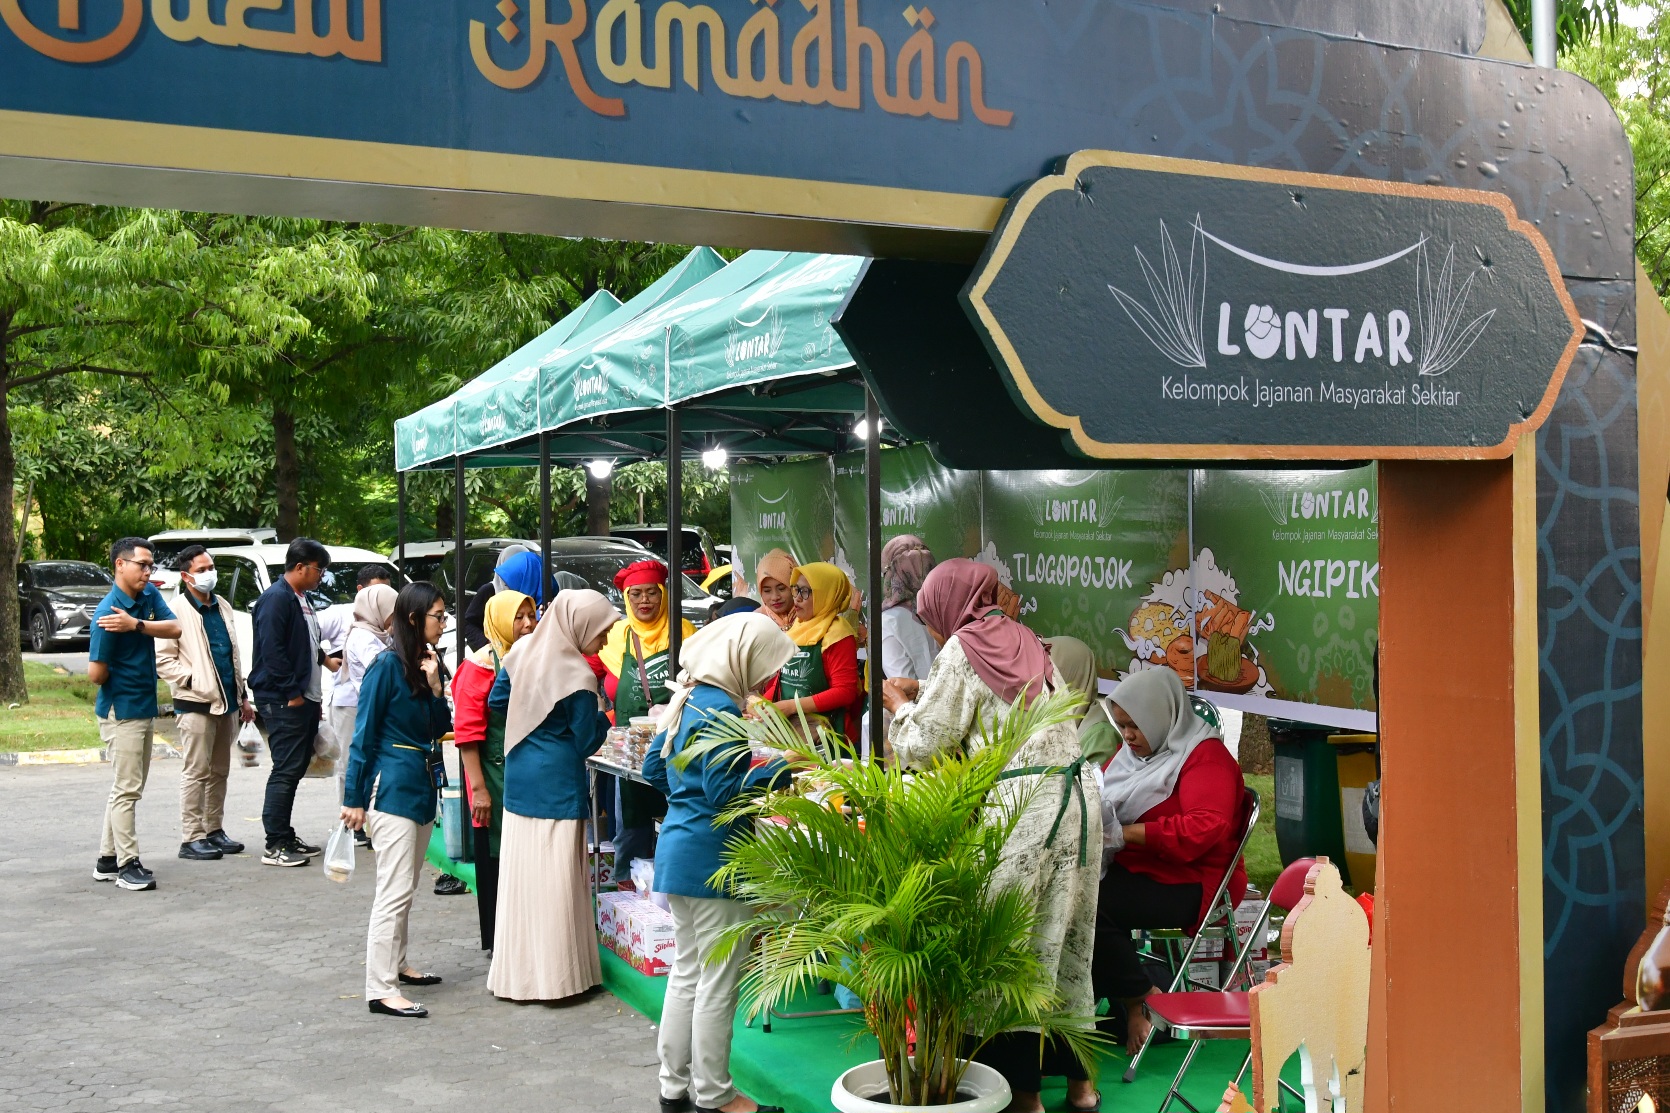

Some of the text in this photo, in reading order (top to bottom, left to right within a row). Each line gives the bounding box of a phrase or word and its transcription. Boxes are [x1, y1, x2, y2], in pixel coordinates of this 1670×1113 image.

[1218, 302, 1413, 366] LONTAR
[1162, 374, 1461, 410] Kelompok Jajanan Masyarakat Sekitar
[759, 511, 786, 529] LONTAR
[880, 504, 916, 526] ONTAR
[1045, 499, 1097, 523] LONTAR
[1290, 488, 1369, 519] LONTAR
[1013, 553, 1133, 590] TLOGOPOJOK
[1278, 559, 1379, 598] NGIPIK
